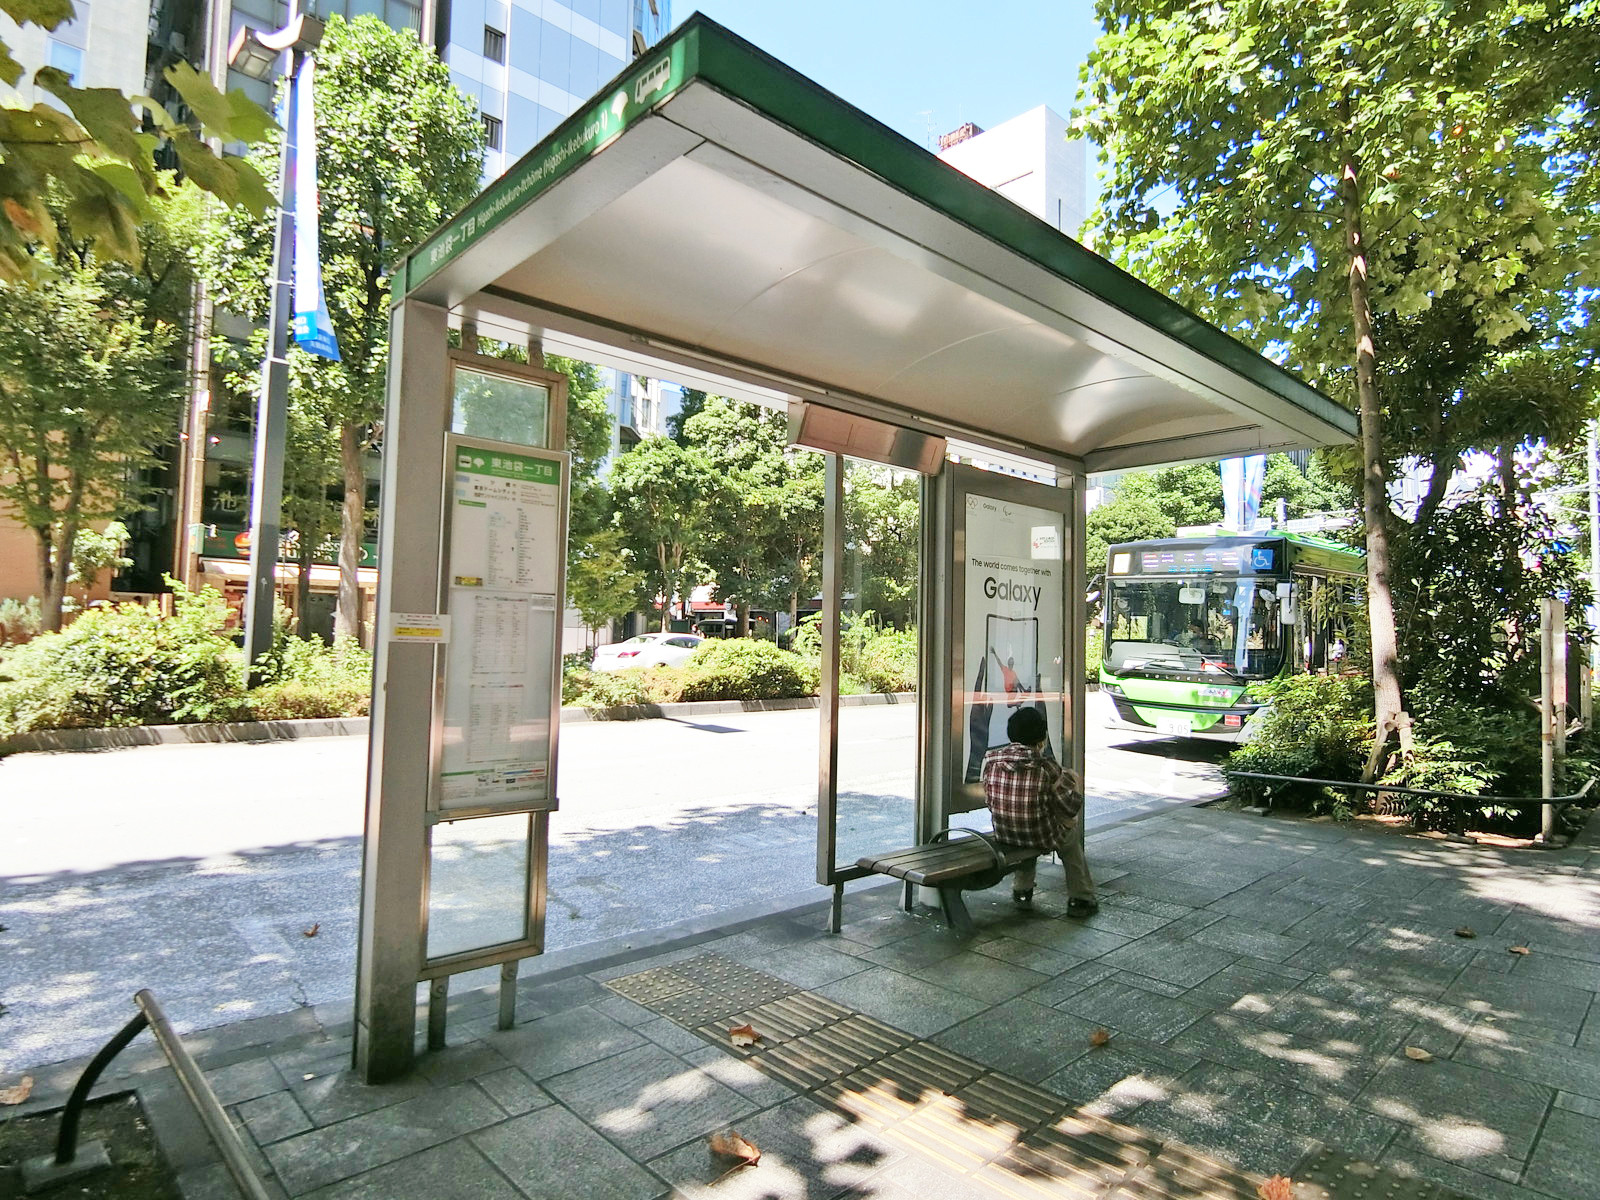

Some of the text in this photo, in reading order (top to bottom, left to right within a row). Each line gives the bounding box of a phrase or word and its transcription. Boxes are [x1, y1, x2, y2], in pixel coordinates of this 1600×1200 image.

[431, 217, 475, 265] 東池袋一丁目
[491, 457, 553, 477] 東池袋一丁目
[972, 558, 1052, 577] The world comes together with
[984, 576, 1041, 612] Galaxy
